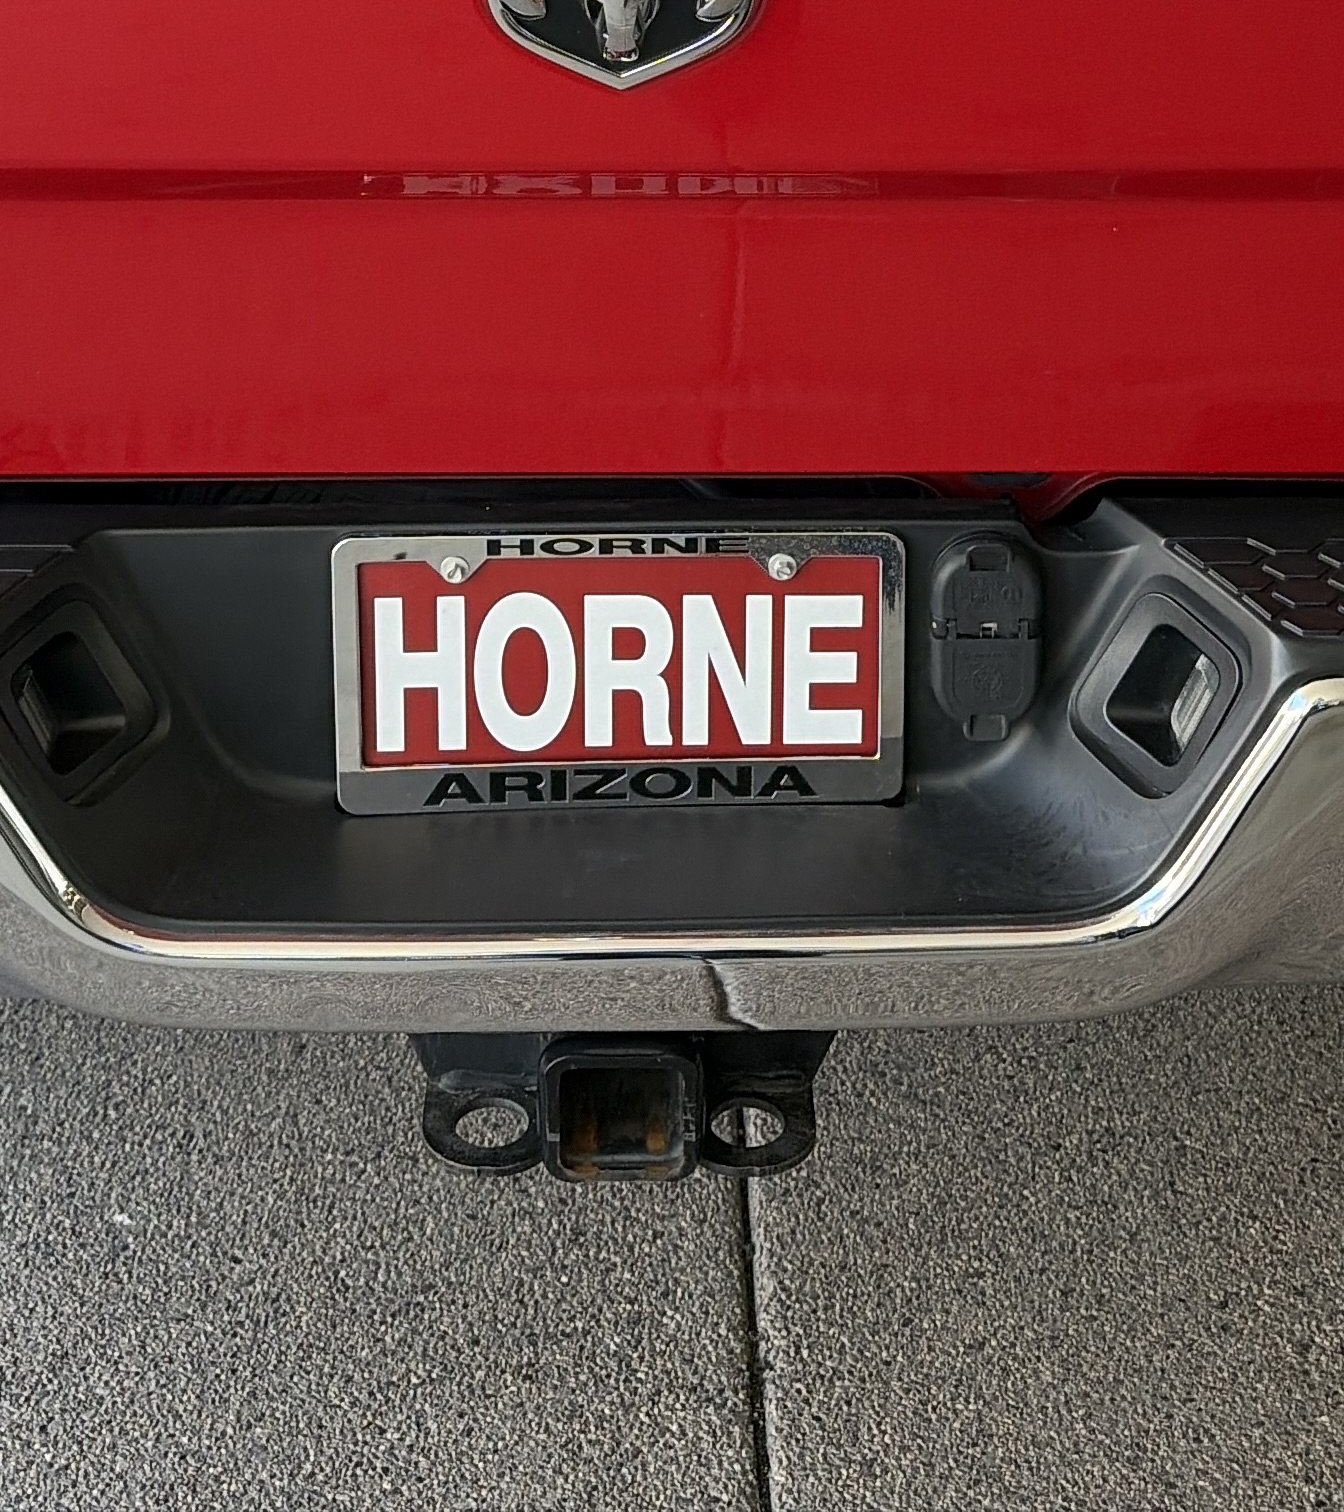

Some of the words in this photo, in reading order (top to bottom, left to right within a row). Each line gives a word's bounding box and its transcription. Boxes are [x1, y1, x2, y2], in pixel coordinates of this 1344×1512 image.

[486, 537, 750, 555] HORNE
[373, 591, 864, 752] HORNE
[422, 764, 818, 807] ARIZONA
